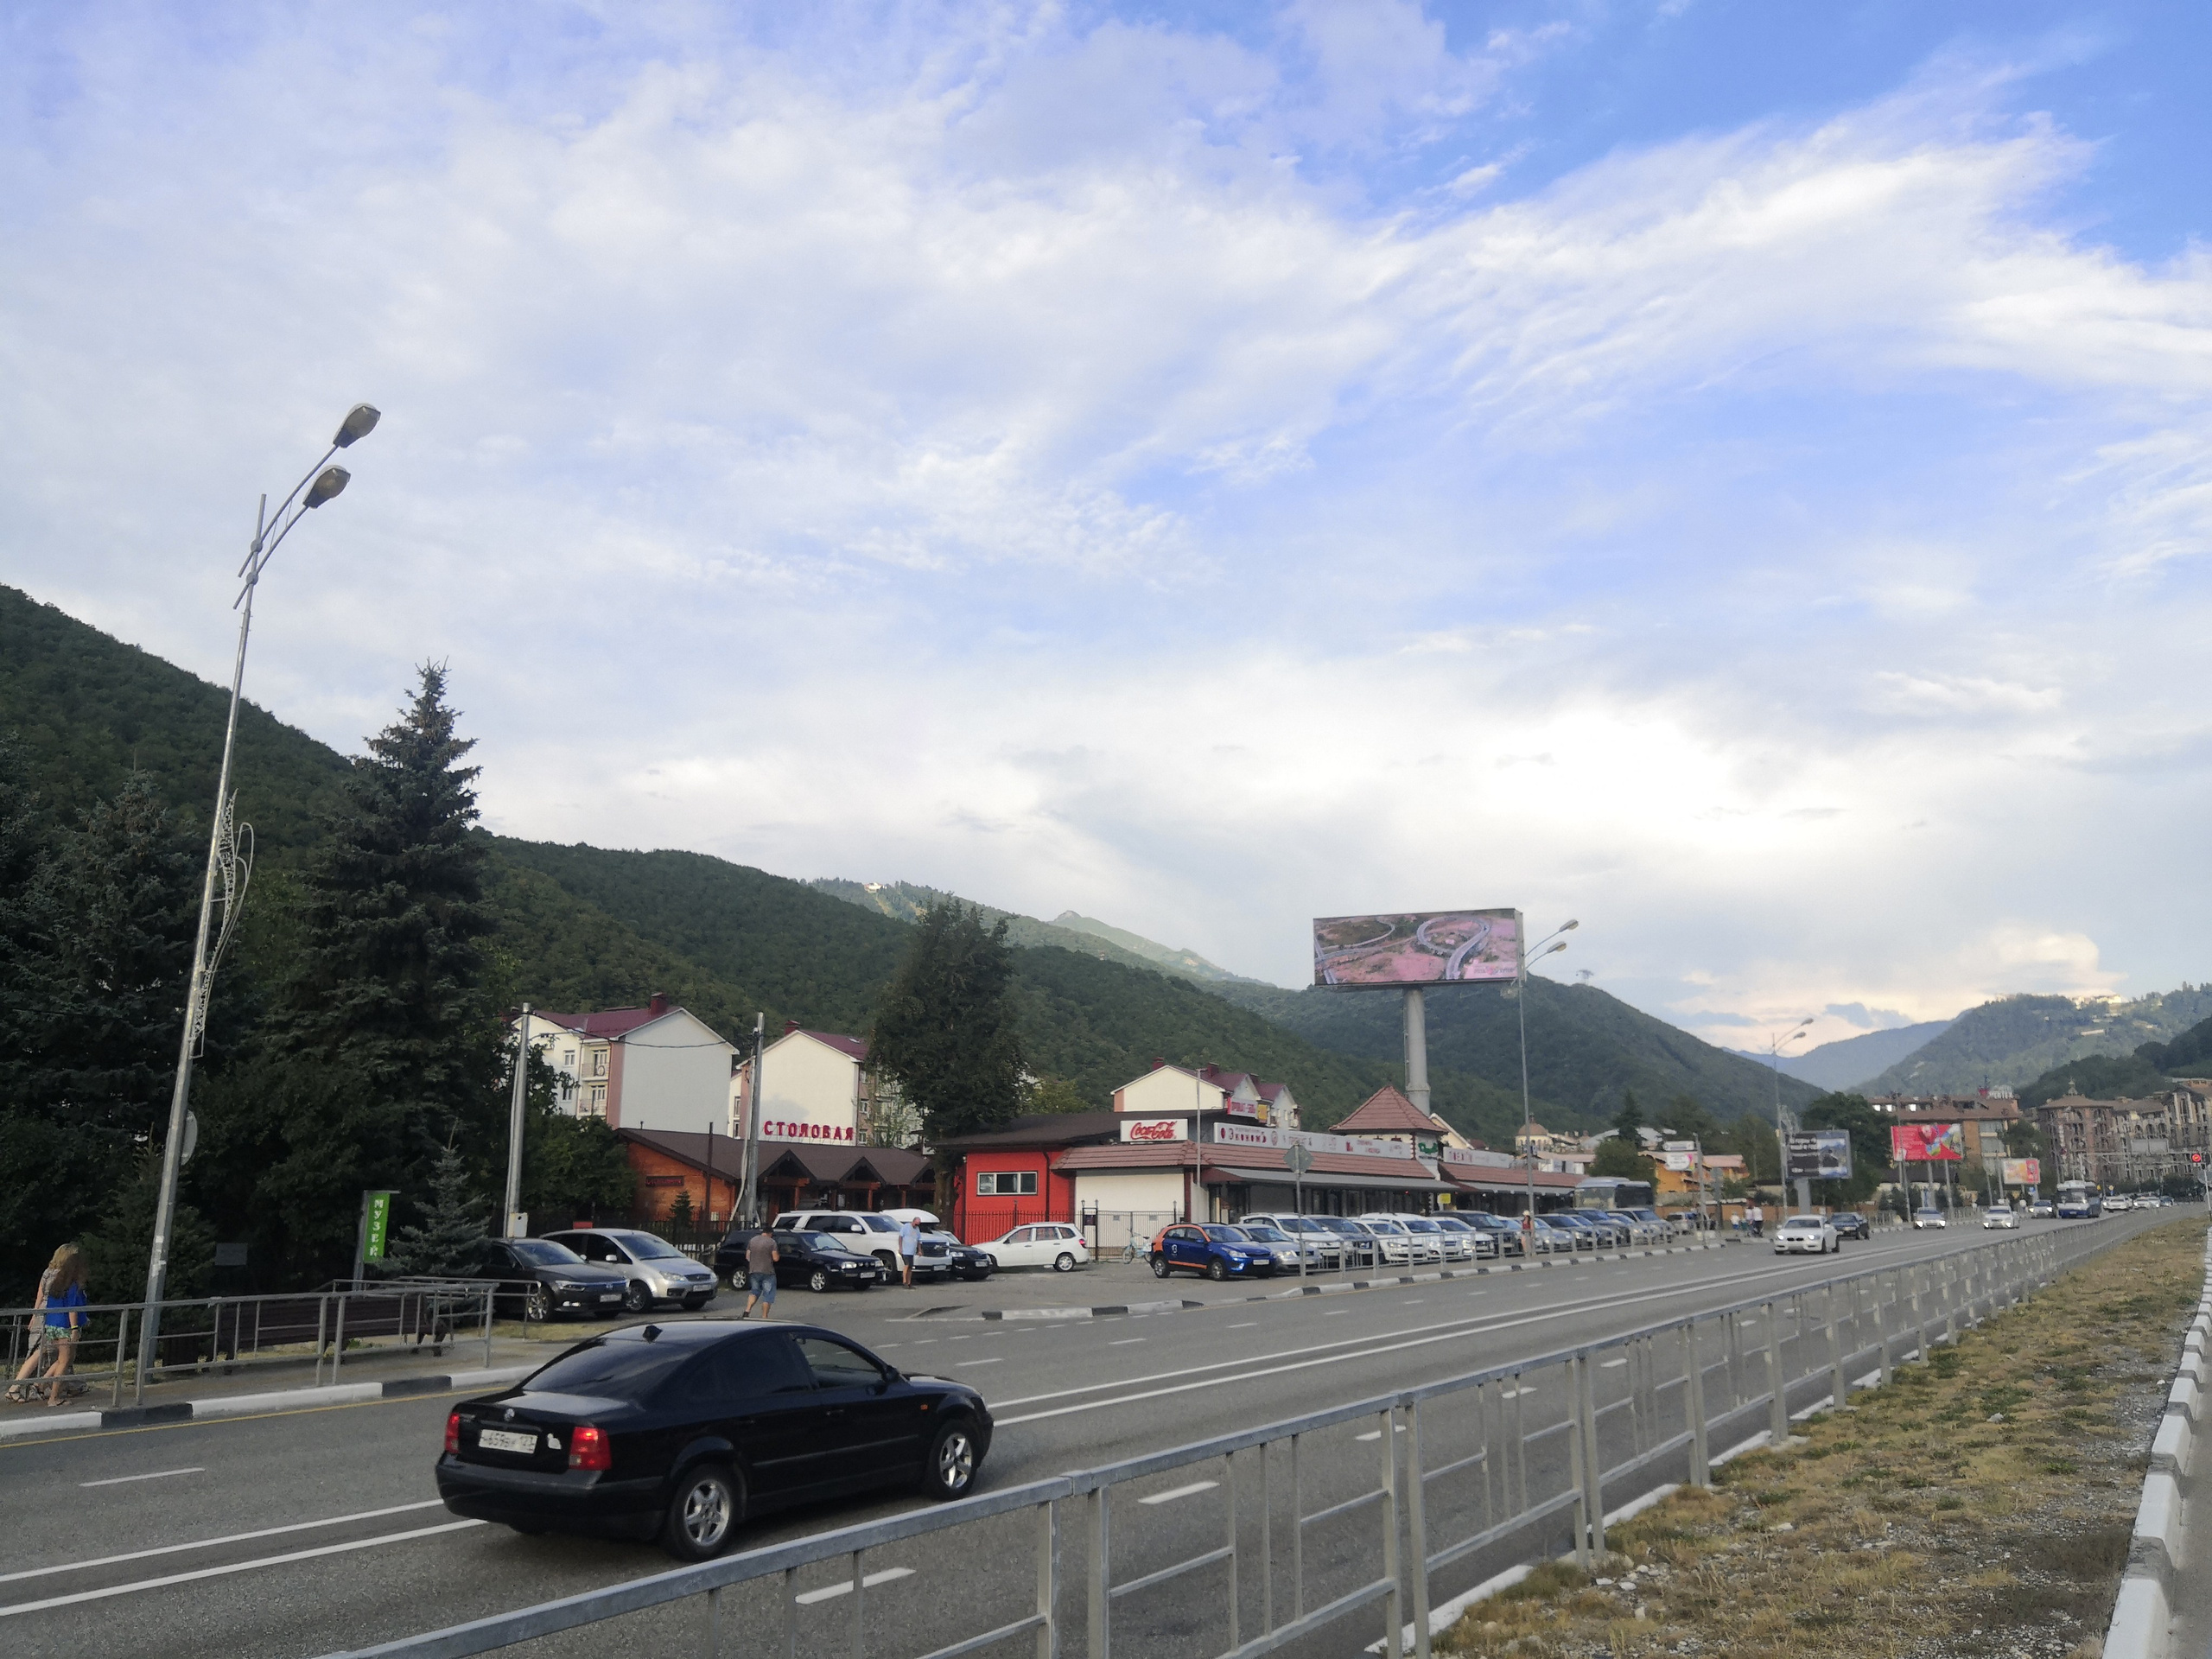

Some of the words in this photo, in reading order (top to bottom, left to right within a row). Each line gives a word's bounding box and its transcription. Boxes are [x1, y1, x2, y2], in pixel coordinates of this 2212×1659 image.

[764, 1121, 854, 1141] СТОЛОВАЯ
[1130, 1121, 1178, 1140] Coca-Cola
[369, 1199, 384, 1256] МУЗЕЙ
